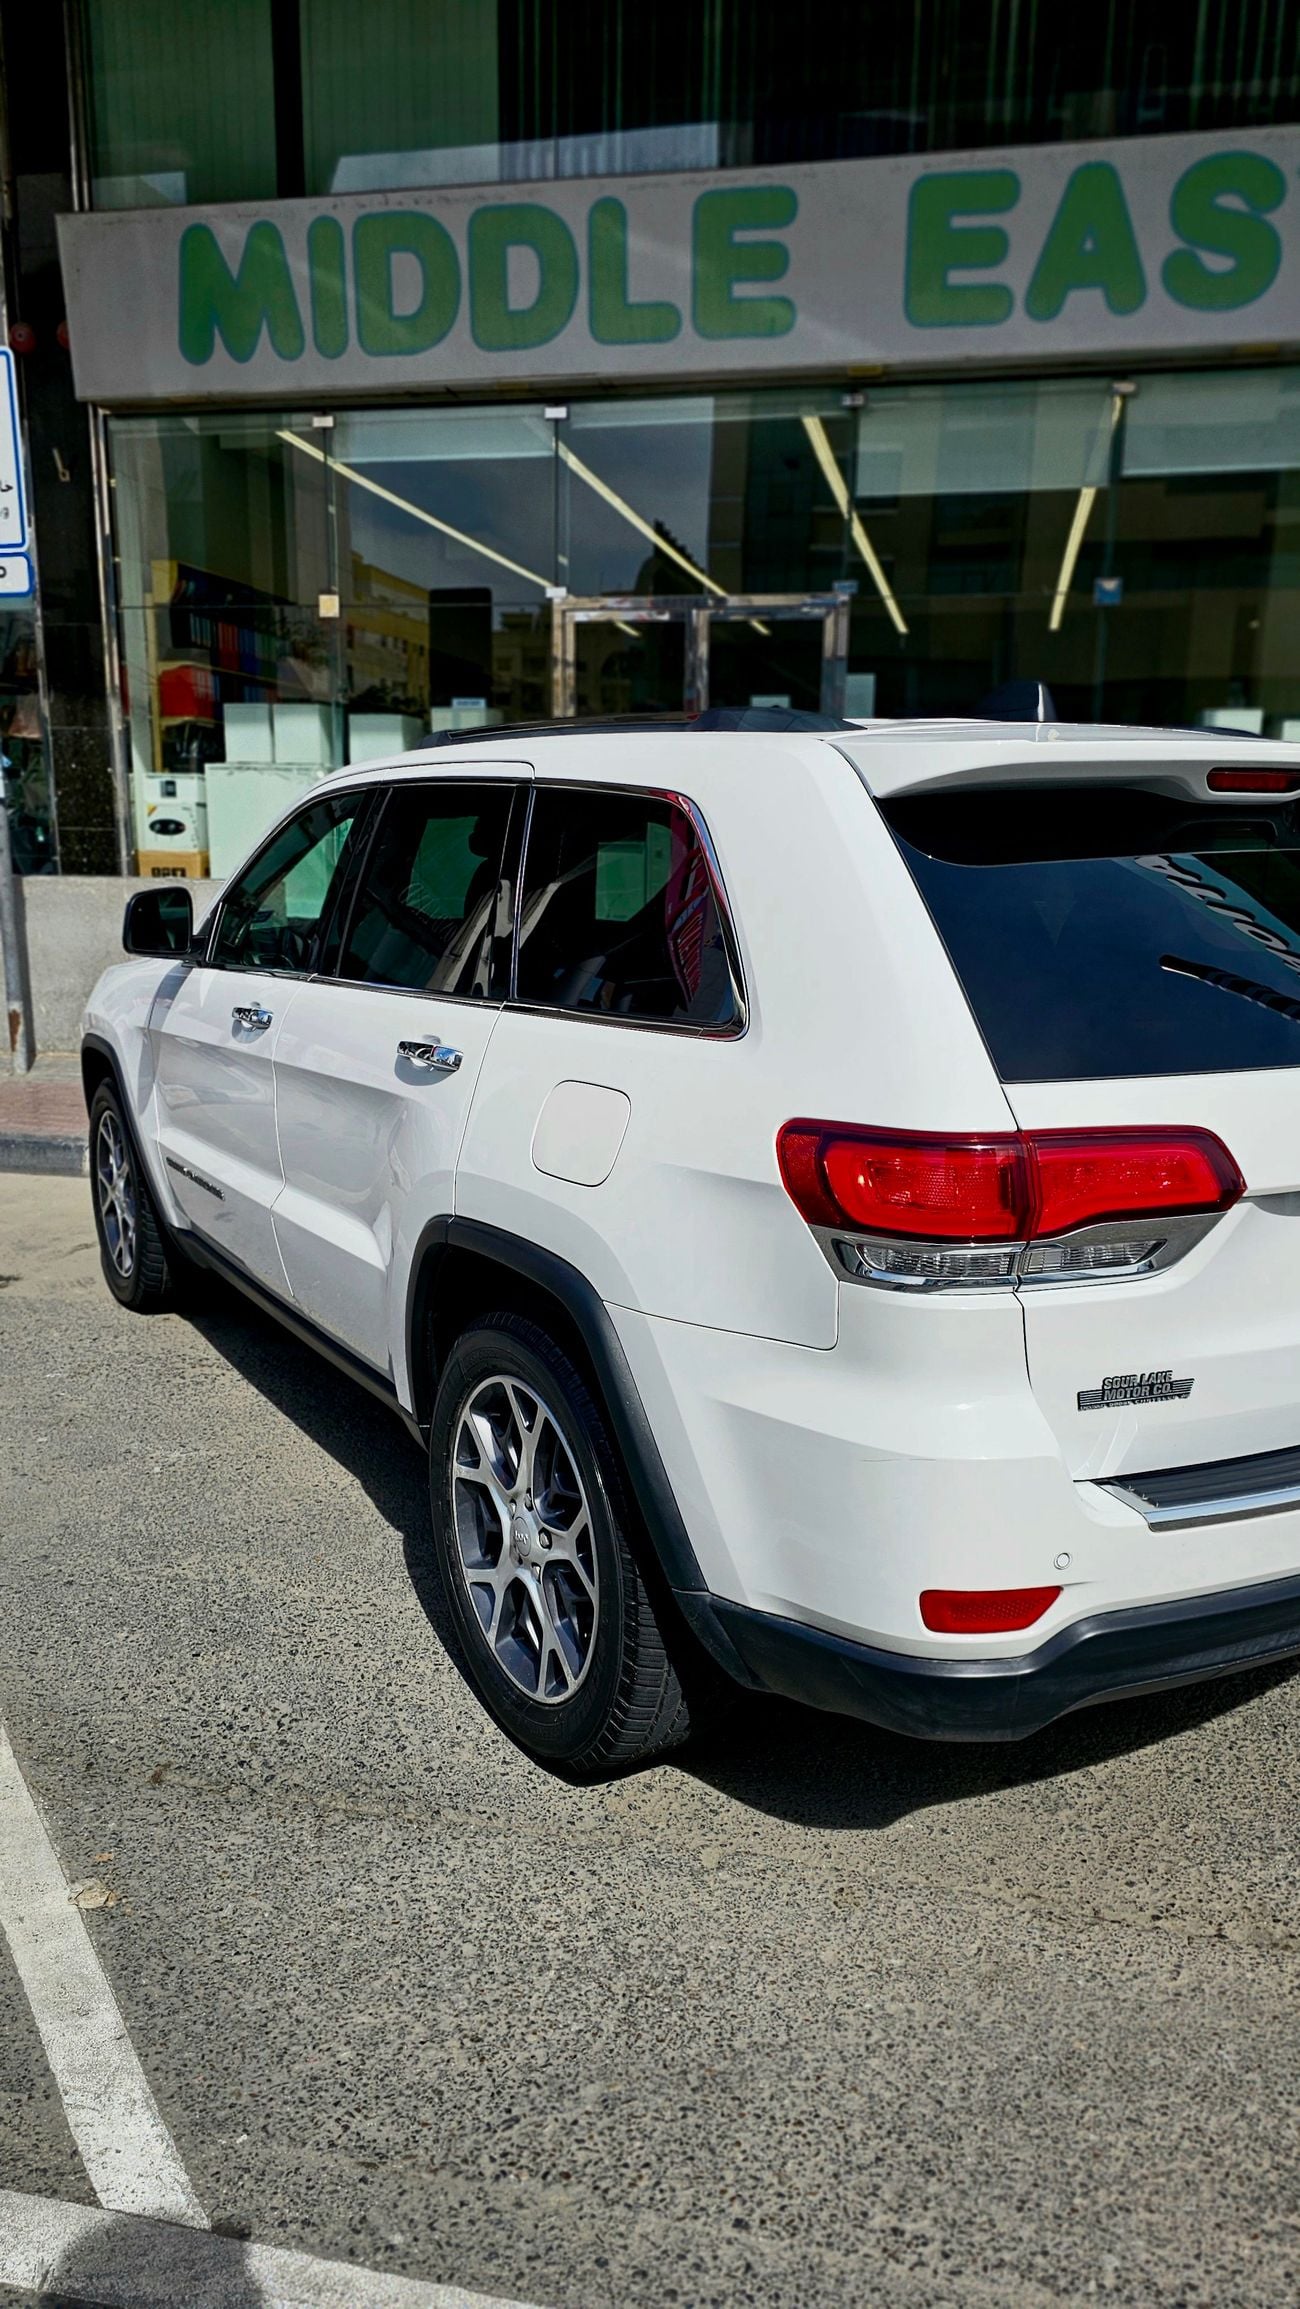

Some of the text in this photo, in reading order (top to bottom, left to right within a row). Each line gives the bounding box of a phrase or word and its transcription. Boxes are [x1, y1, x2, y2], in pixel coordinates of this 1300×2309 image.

[178, 150, 1300, 366] MIDDLE EAS
[1102, 1370, 1173, 1390] SOUR LAKE
[1103, 1384, 1150, 1401] MOTOR
